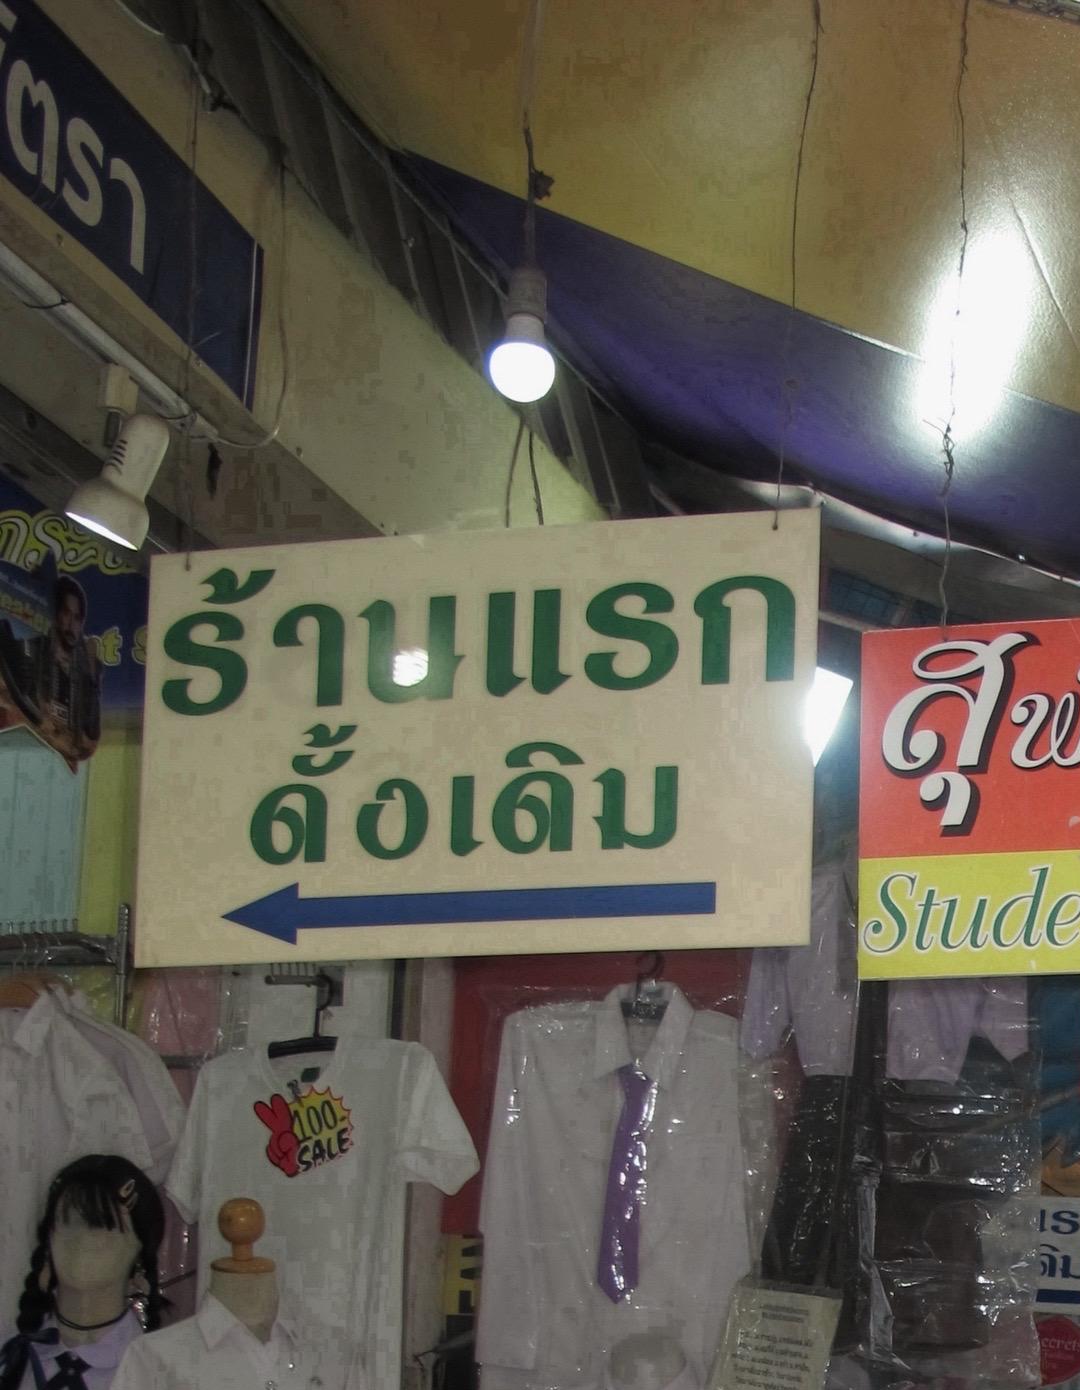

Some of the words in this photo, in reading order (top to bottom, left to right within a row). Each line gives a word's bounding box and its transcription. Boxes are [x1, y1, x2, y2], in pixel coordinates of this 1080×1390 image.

[160, 567, 797, 716] ร้านแรก
[249, 722, 679, 865] ดั้งเดิม
[298, 1127, 350, 1172] SALE
